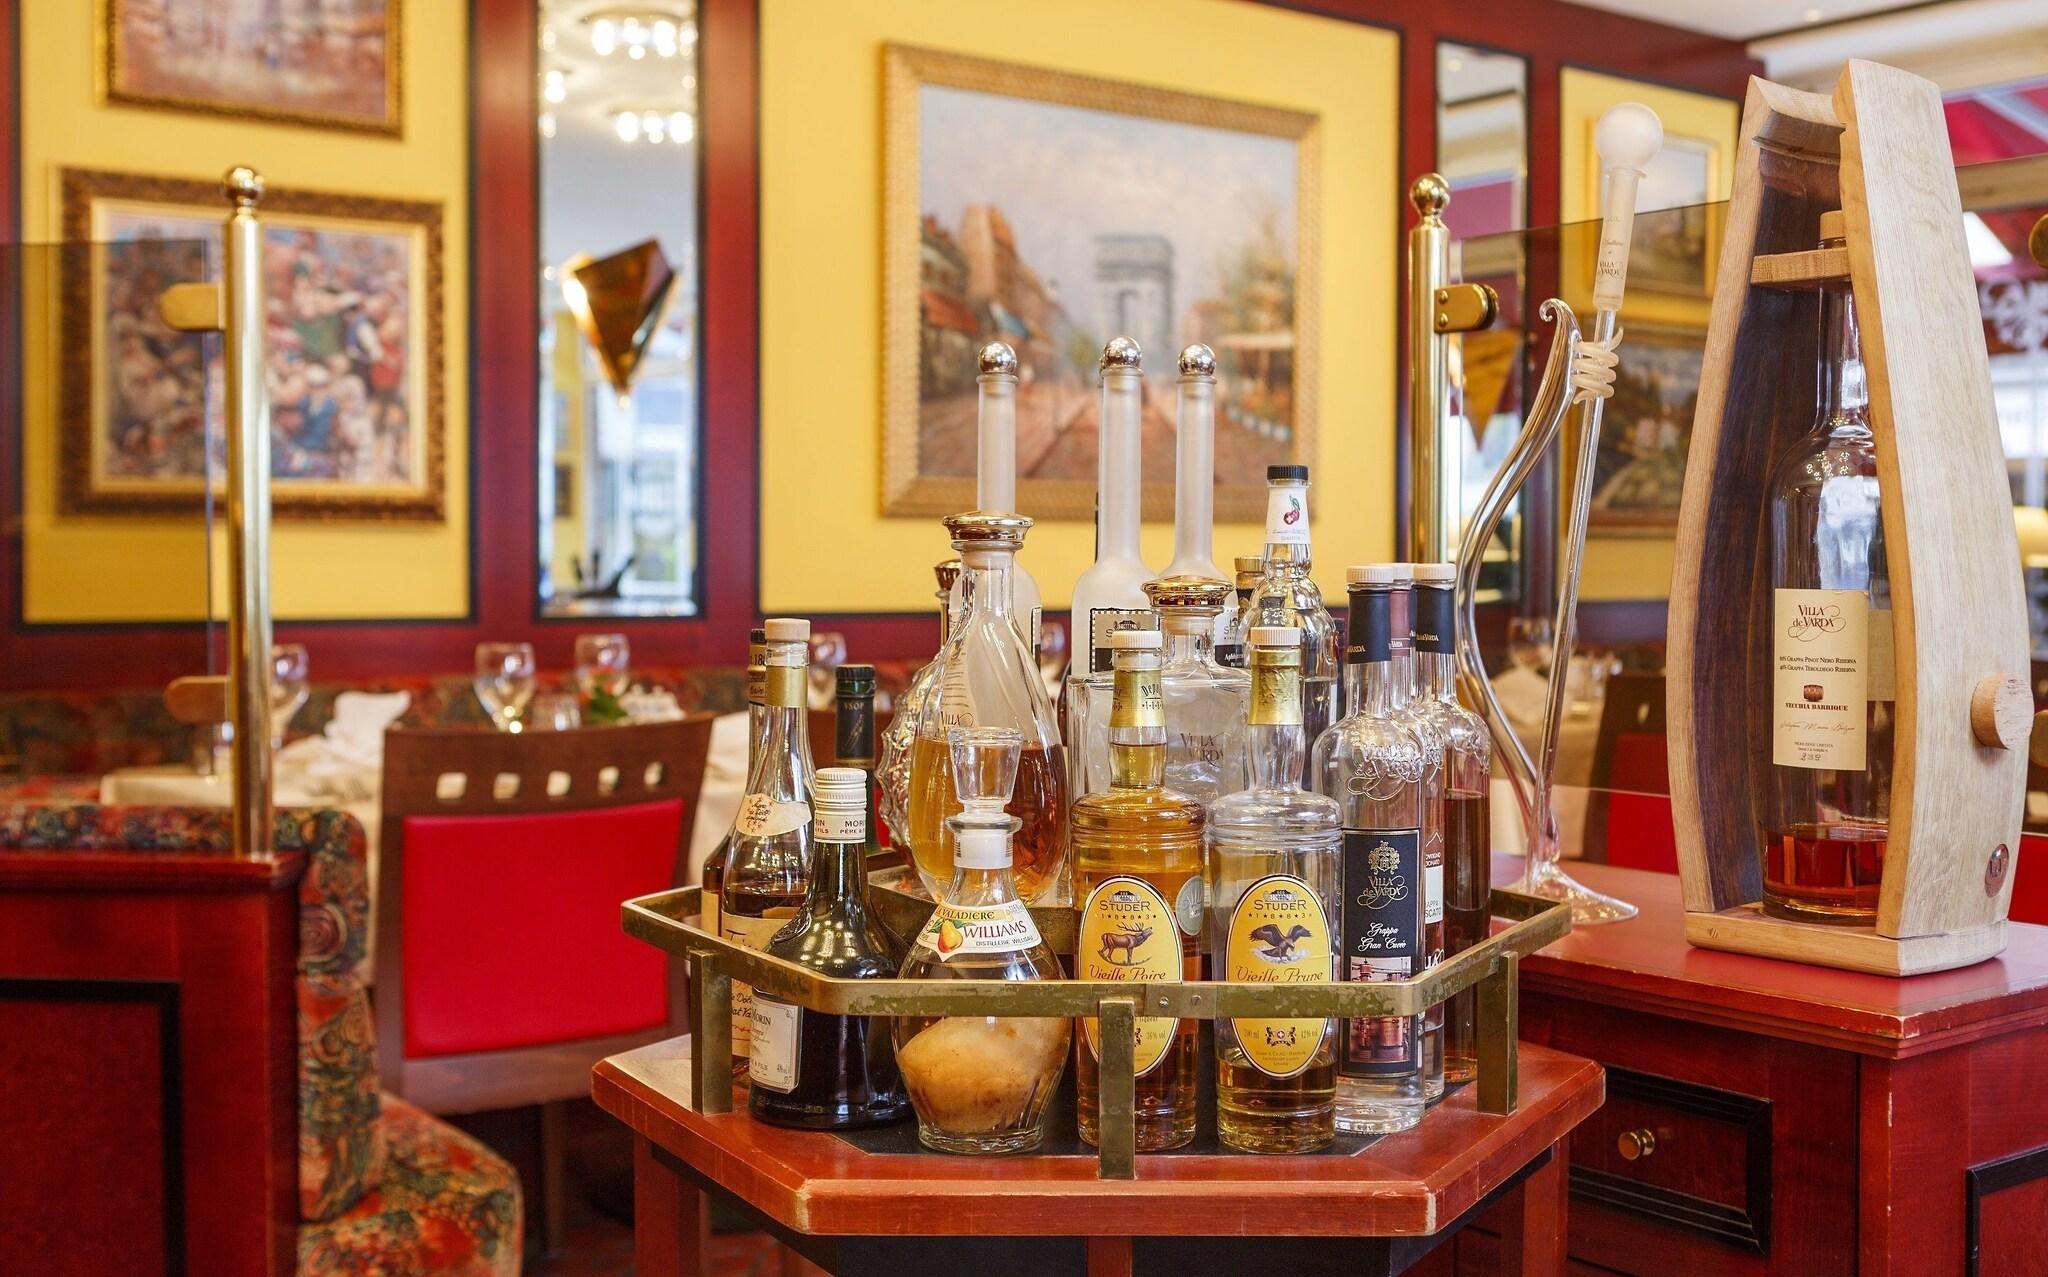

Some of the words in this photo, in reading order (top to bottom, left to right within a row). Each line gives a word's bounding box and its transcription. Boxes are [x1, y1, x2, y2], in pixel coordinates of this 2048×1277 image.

[1798, 604, 1832, 617] VILLA
[844, 702, 865, 710] VSOP
[1785, 702, 1810, 710] VECCHIA
[1811, 703, 1849, 712] BARRIQUE
[1099, 899, 1152, 912] STUDER
[1254, 899, 1308, 911] STUDER
[963, 920, 1028, 939] WILLIAMS
[1366, 922, 1400, 938] Grappa
[1357, 936, 1383, 952] Gran
[1088, 963, 1126, 981] Vieille
[1130, 966, 1167, 981] Poire
[1236, 965, 1280, 983] Vieille
[1283, 967, 1324, 983] Prune
